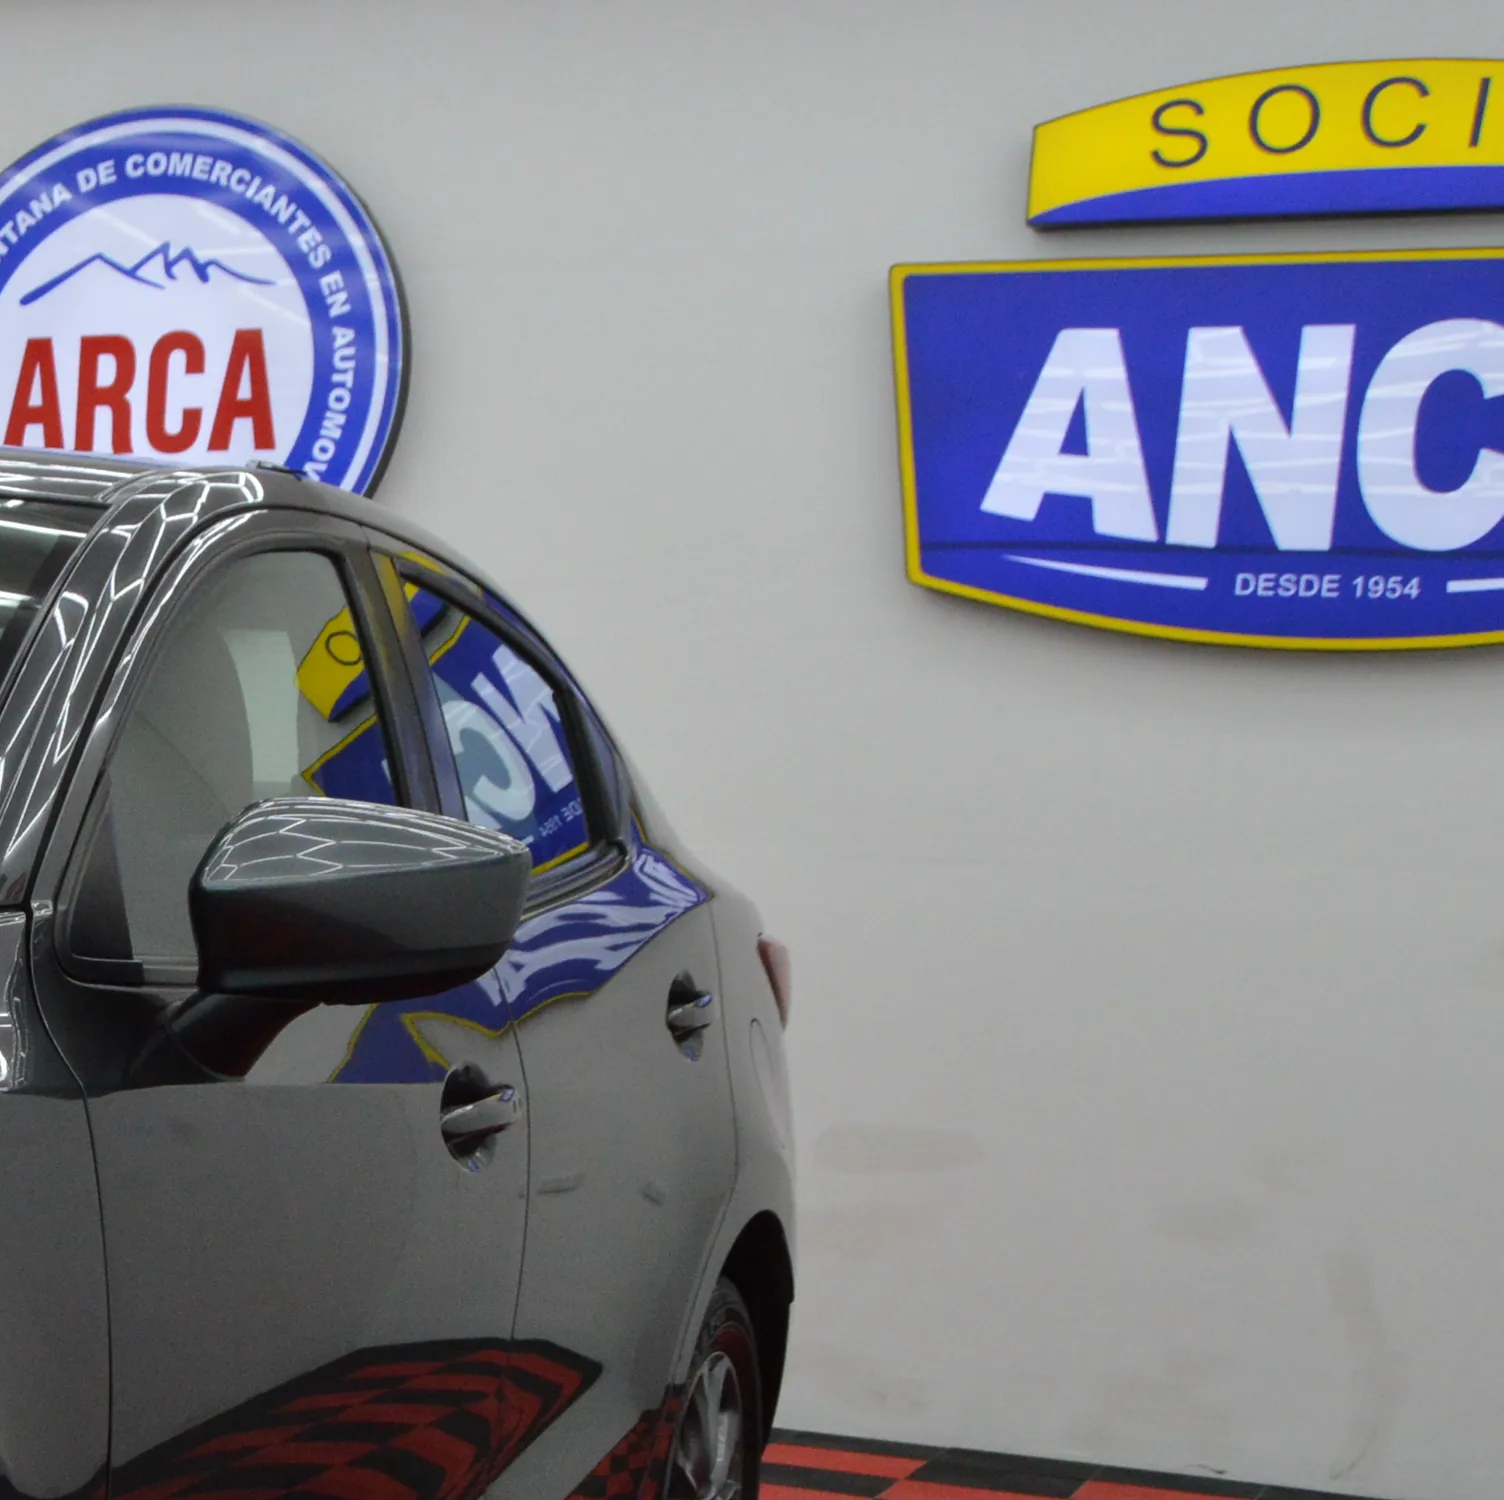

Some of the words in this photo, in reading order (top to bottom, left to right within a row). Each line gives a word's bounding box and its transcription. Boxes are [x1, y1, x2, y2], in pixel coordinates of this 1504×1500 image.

[1150, 76, 1492, 169] SOCI
[77, 159, 117, 192] DE
[125, 151, 333, 272] COMERCIANTES
[319, 270, 351, 317] EN
[2, 327, 276, 455] ARCA
[979, 317, 1504, 552] ANC
[1233, 572, 1342, 599] DESDE
[1351, 575, 1421, 601] 1954
